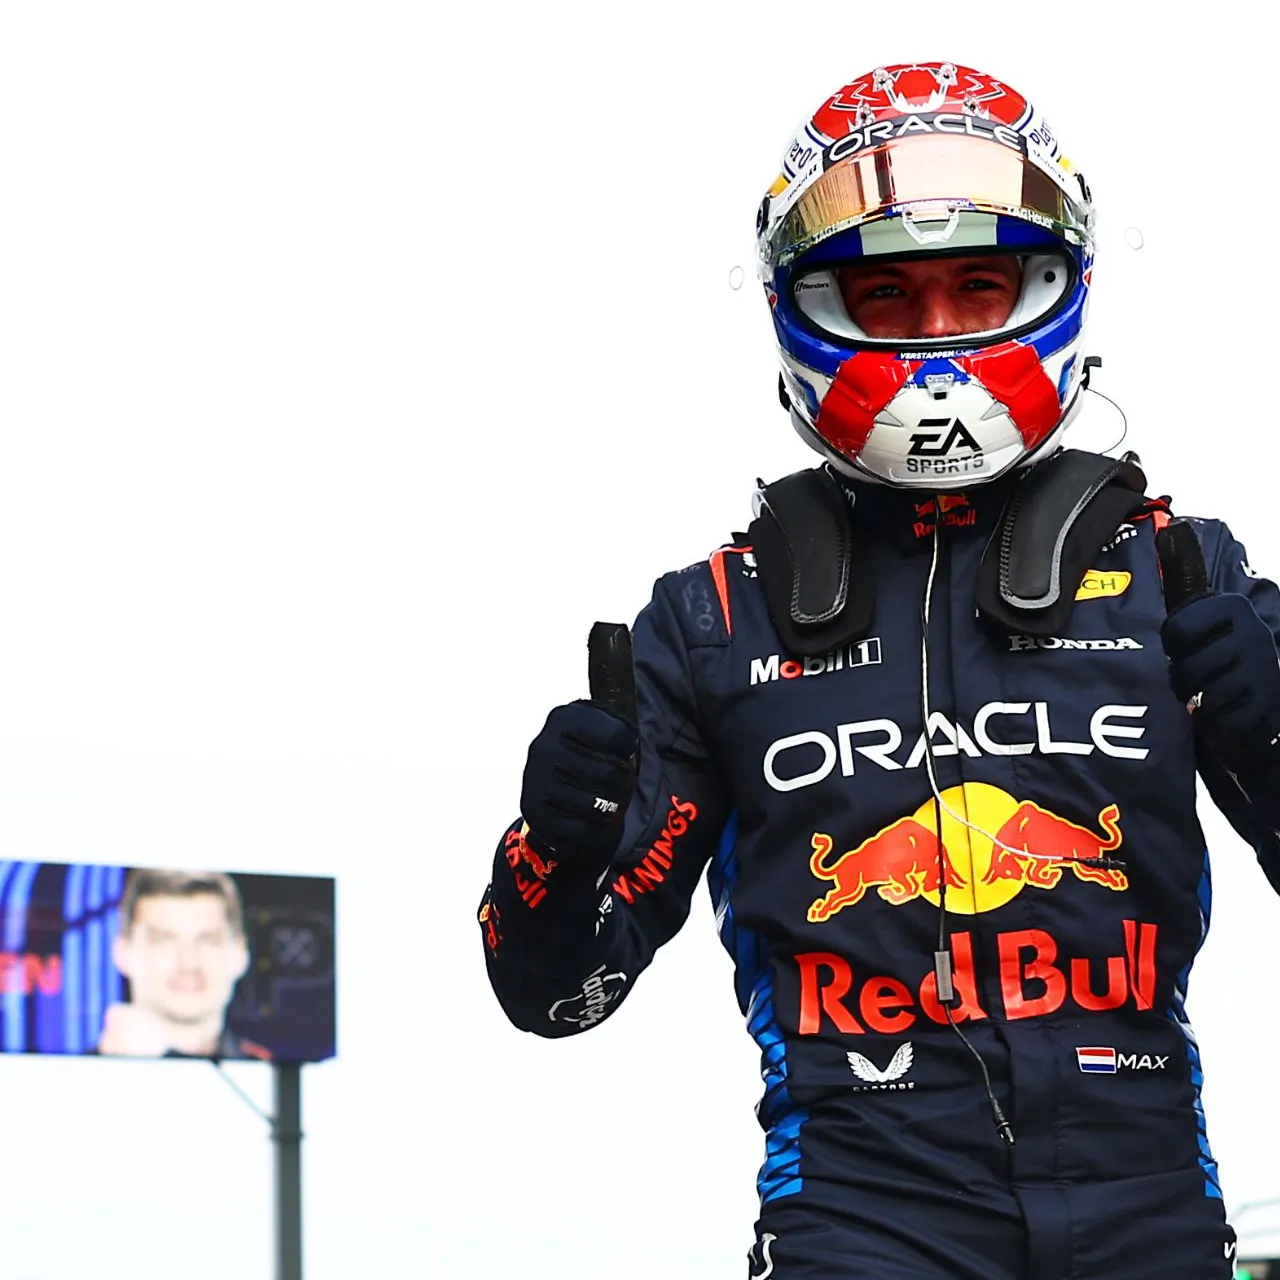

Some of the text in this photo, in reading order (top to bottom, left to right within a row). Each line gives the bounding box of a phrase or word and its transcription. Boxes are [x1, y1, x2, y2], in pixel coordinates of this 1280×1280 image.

[829, 114, 1022, 162] ORACLE
[907, 417, 983, 456] EA
[906, 453, 984, 474] SPORTS
[1008, 635, 1144, 651] HONDA
[749, 650, 844, 686] Mobil
[762, 701, 1151, 793] ORACLE
[794, 918, 1159, 1036] Red Bull
[1116, 1052, 1170, 1070] MAX
